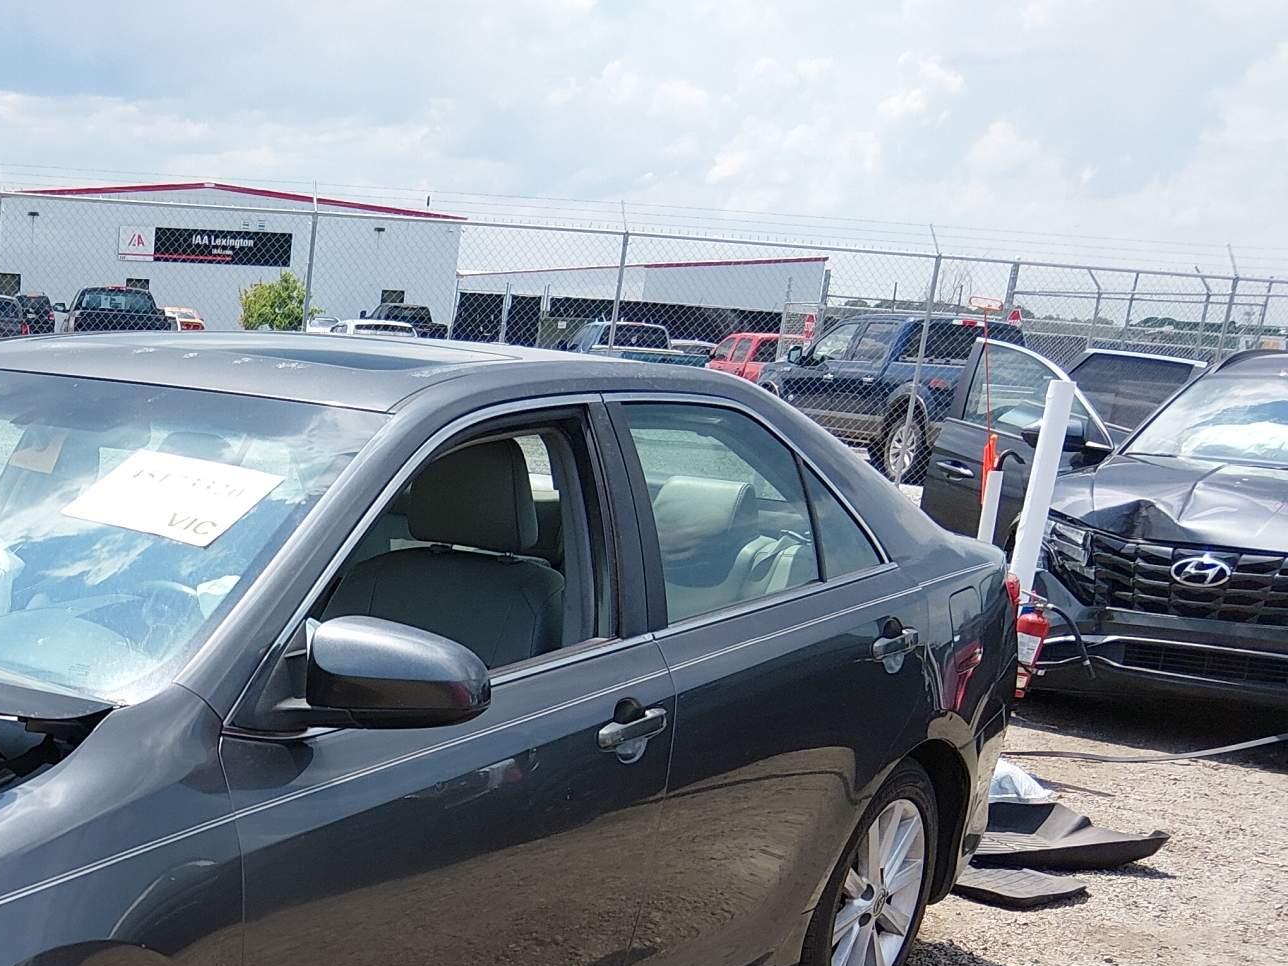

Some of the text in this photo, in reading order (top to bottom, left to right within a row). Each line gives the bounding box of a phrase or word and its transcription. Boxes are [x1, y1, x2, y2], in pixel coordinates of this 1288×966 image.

[192, 234, 254, 249] IAA Lexington
[167, 512, 217, 536] VIC
